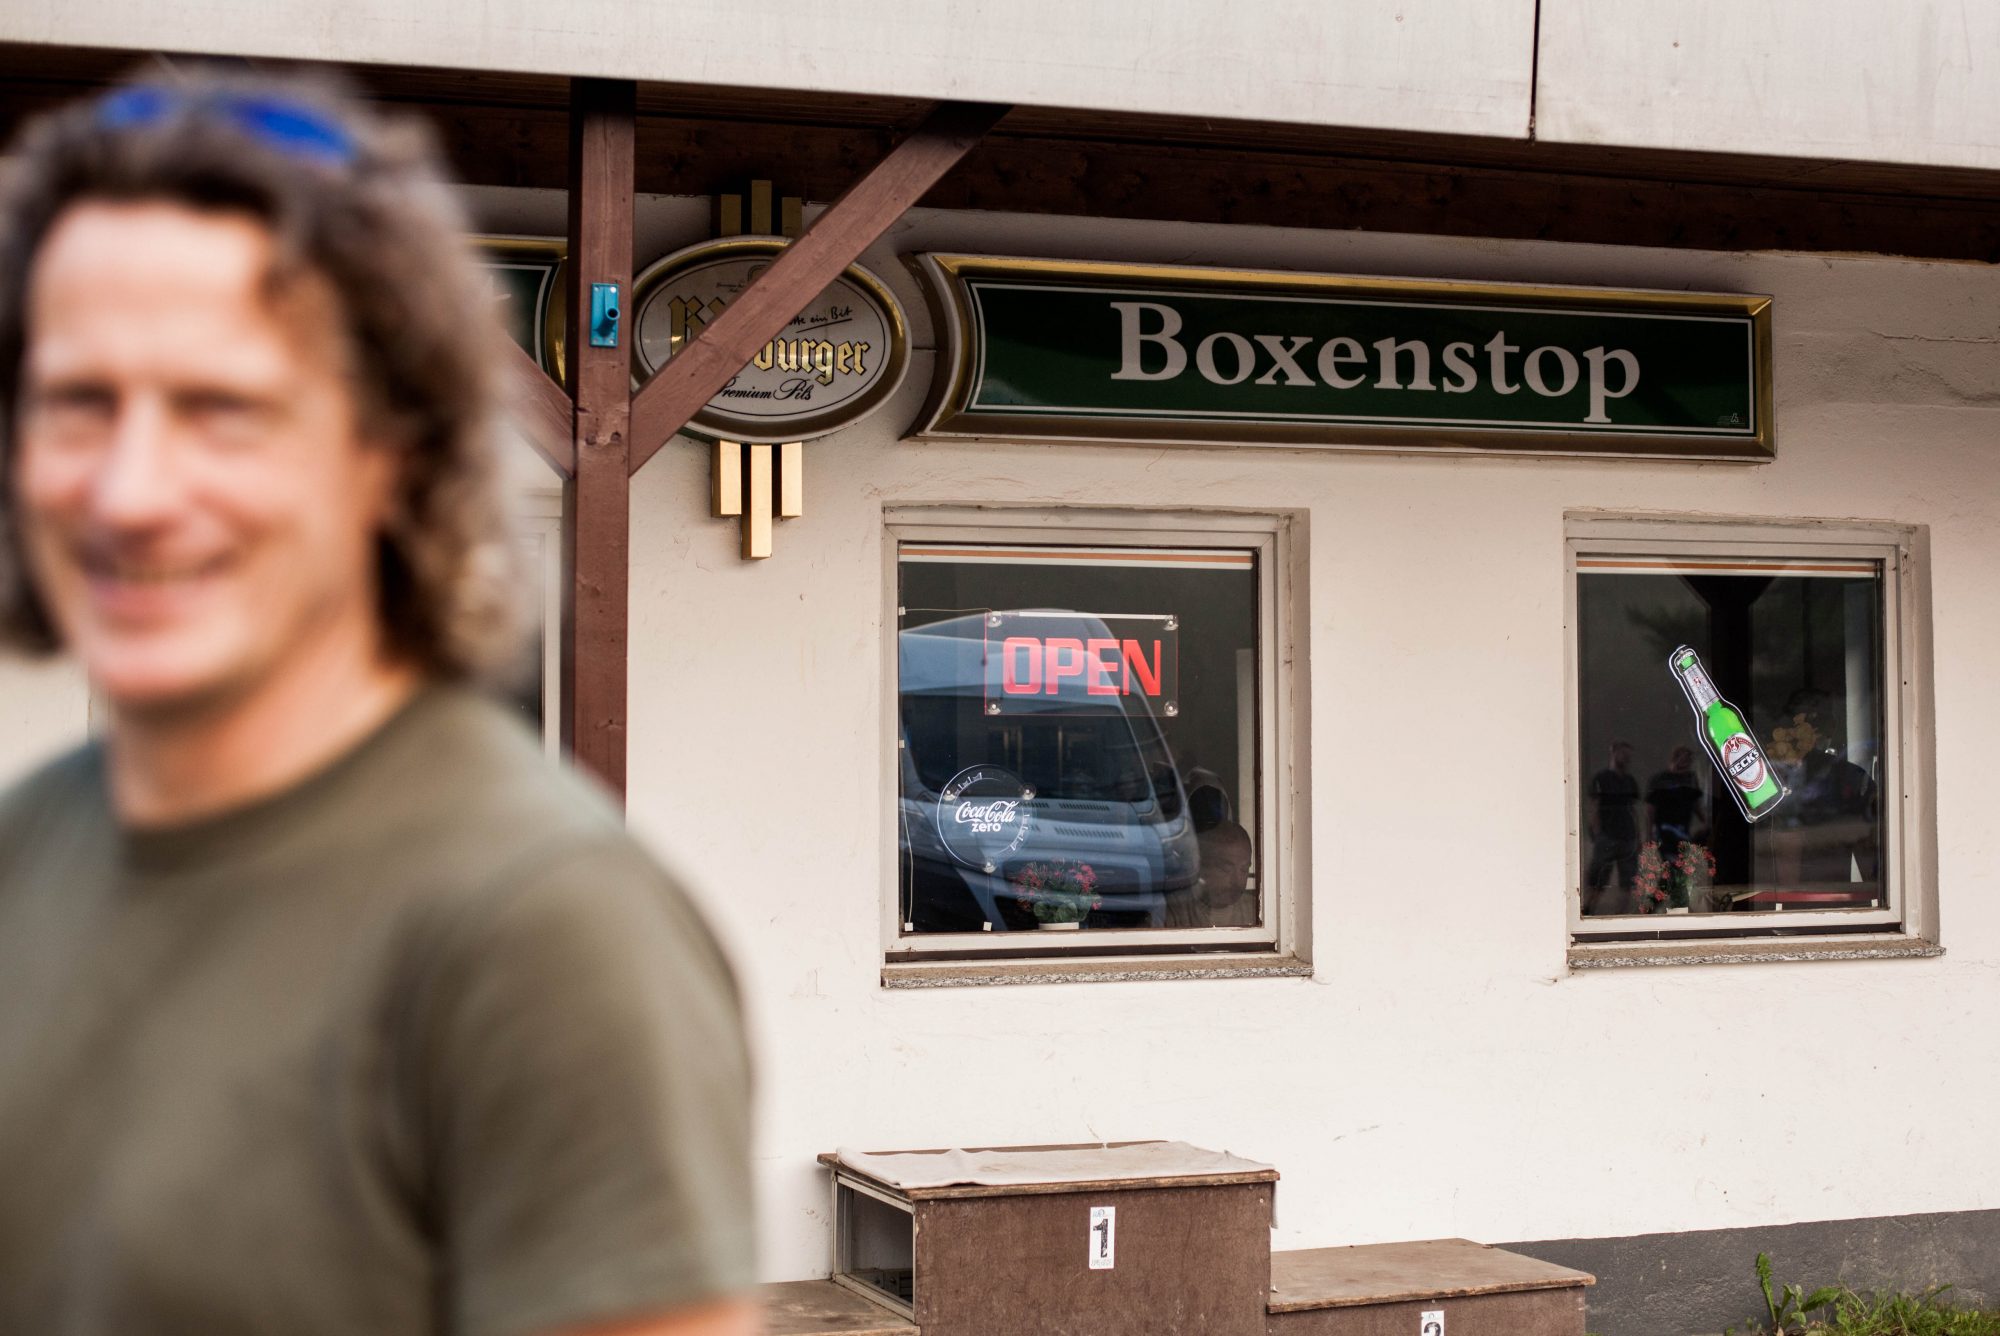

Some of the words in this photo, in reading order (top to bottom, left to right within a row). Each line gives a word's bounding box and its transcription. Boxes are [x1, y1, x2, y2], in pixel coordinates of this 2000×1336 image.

[830, 306, 853, 320] Bit
[1109, 301, 1641, 424] Boxenstop
[718, 376, 773, 400] remium
[773, 378, 814, 401] Pils
[1002, 636, 1162, 697] OPEN
[955, 800, 1020, 824] Coca-Cola
[971, 822, 1002, 833] zero
[1092, 1218, 1109, 1258] 1
